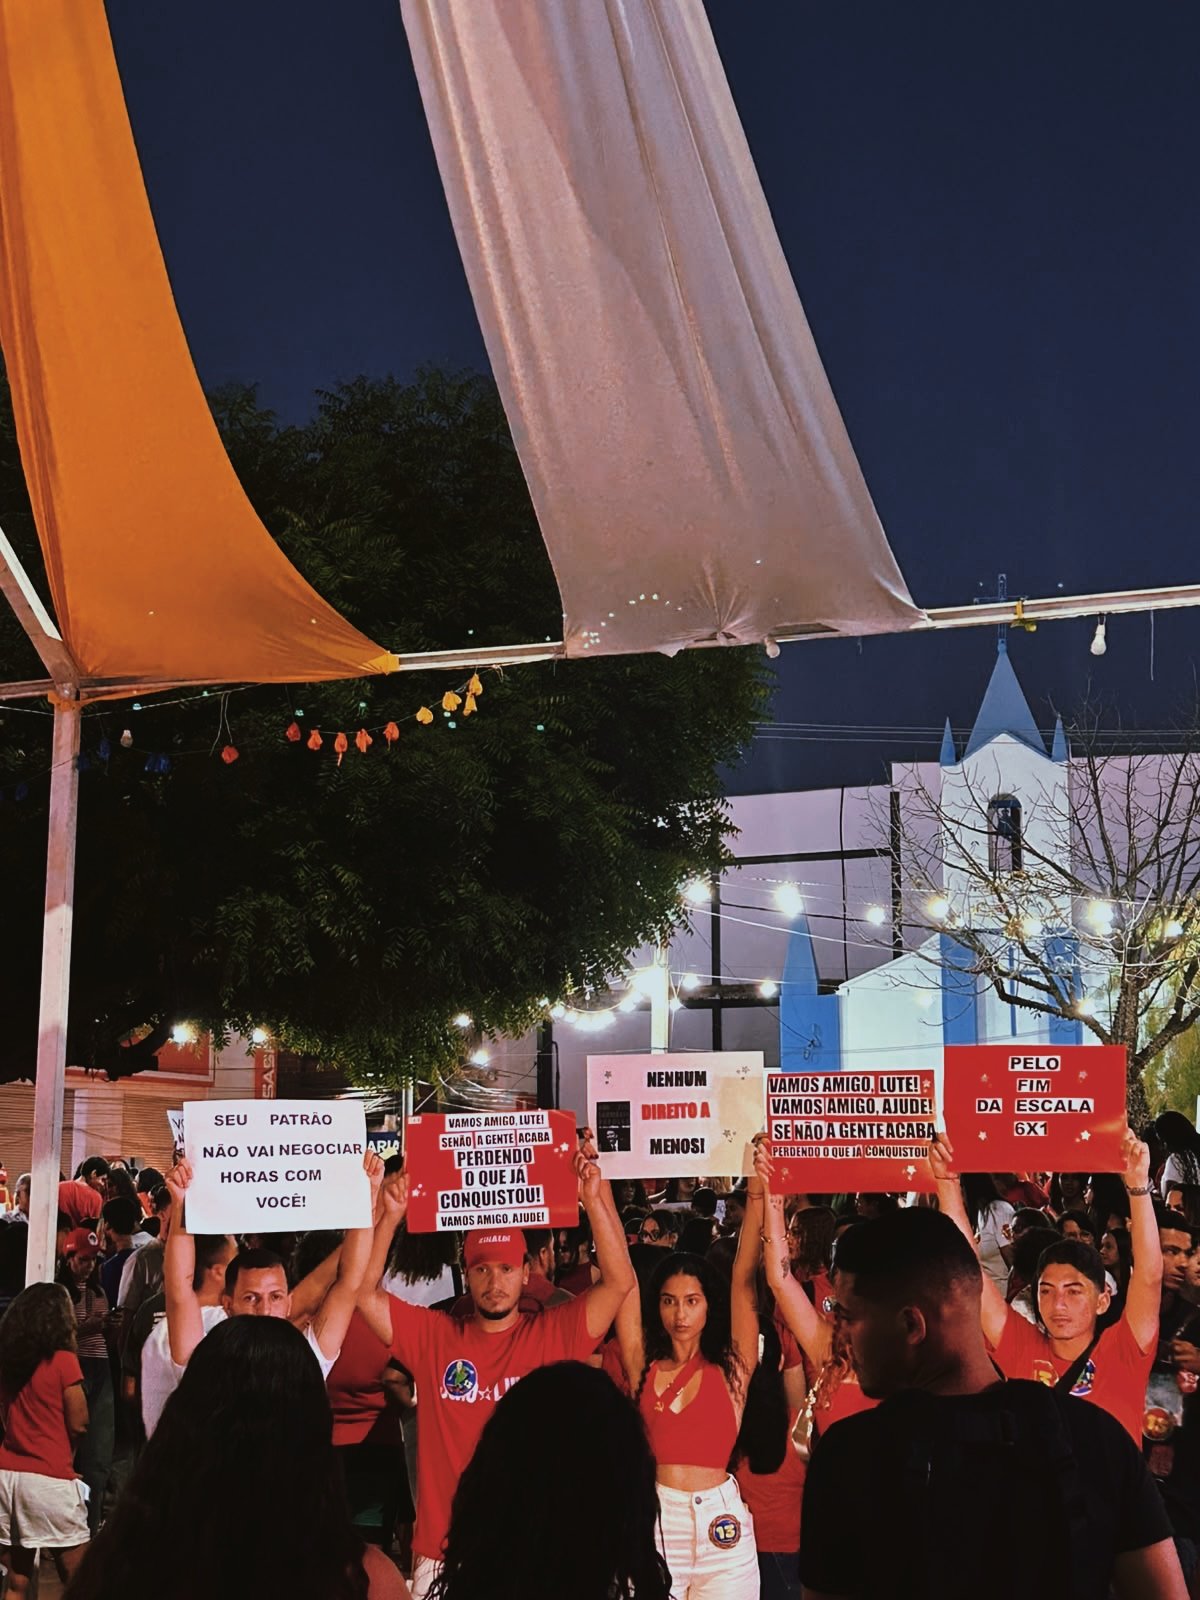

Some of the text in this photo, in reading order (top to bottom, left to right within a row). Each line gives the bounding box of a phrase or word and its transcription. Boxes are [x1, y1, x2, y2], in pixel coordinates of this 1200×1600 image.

[1010, 1057, 1059, 1070] PELO
[647, 1070, 707, 1088] NENHUM
[769, 1076, 918, 1093] VAMOS AMIGO, LUTE!
[1017, 1079, 1050, 1092] FIM
[641, 1103, 697, 1120] DIREITO
[700, 1102, 711, 1118] A
[772, 1098, 933, 1115] VAMOS AMIGO, AJUDE!
[977, 1099, 1092, 1112] DA ESCALA
[214, 1112, 333, 1126] SEU PATRÃO
[448, 1117, 482, 1128] VAMOS
[484, 1115, 518, 1127] AMIGO,
[774, 1121, 937, 1140] SE NÃO A GENTE ACABA
[1015, 1122, 1048, 1135] 6X1
[441, 1131, 550, 1148] SENÃO A GENTE ACABA
[650, 1137, 705, 1155] MENOS!
[203, 1143, 363, 1158] NÃO VAI NEGOCIAR
[457, 1148, 532, 1167] PERDENDO
[773, 1146, 820, 1157] PERDENDO
[823, 1147, 829, 1157] O
[831, 1147, 850, 1158] QUE
[865, 1146, 928, 1158] CONQUISTOU
[221, 1169, 321, 1183] HORAS COM
[465, 1165, 526, 1187] O QUE JÁ
[256, 1193, 306, 1208] VOCÊ!
[440, 1187, 541, 1209] CONQUISTOU!
[441, 1216, 475, 1227] VAMOS
[477, 1213, 511, 1225] AMIGO,
[716, 1524, 736, 1540] 13
